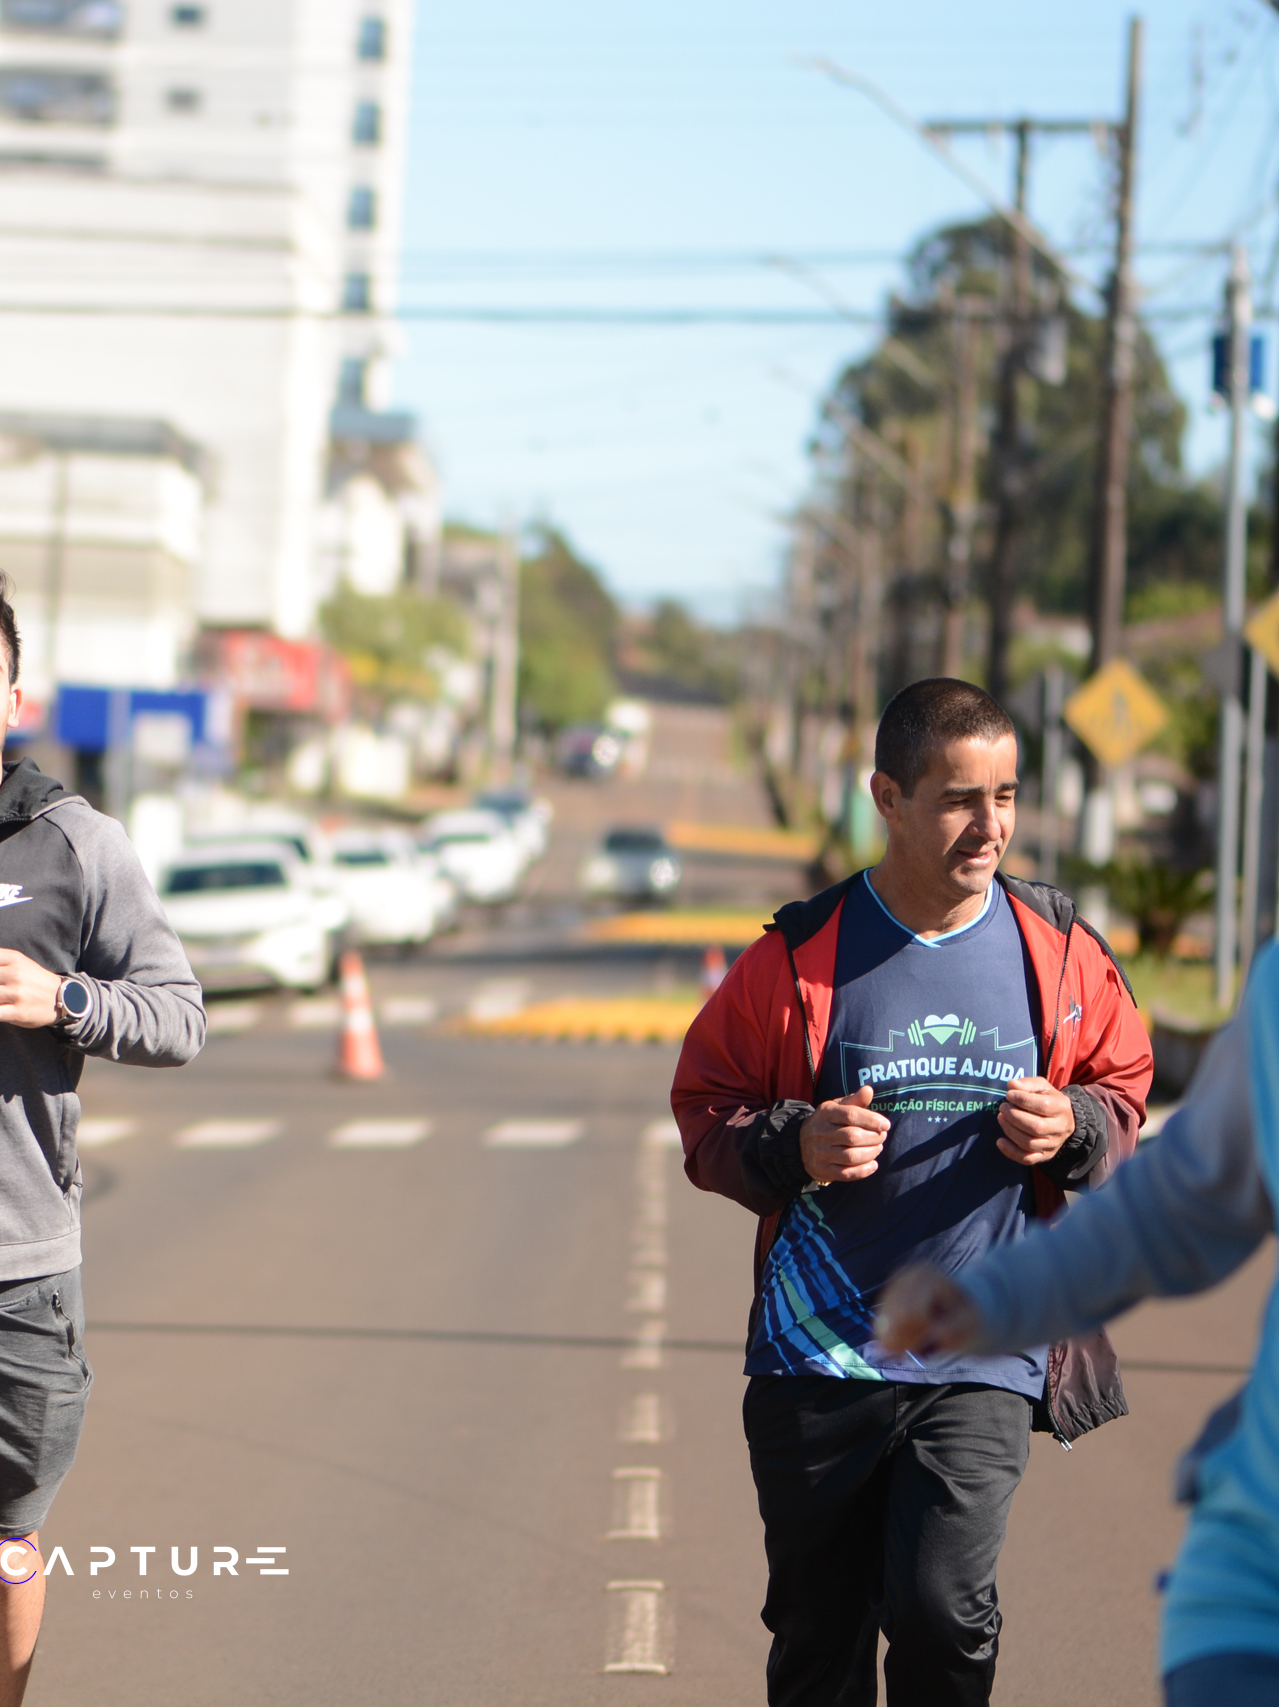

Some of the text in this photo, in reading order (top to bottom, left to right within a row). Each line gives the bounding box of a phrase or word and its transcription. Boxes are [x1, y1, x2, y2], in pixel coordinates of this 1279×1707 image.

[857, 1056, 1026, 1087] PRATIQUE AJUDA
[867, 1098, 924, 1114] DUCAÇÃO
[925, 1098, 964, 1112] FÍSICA
[966, 1101, 983, 1112] EM
